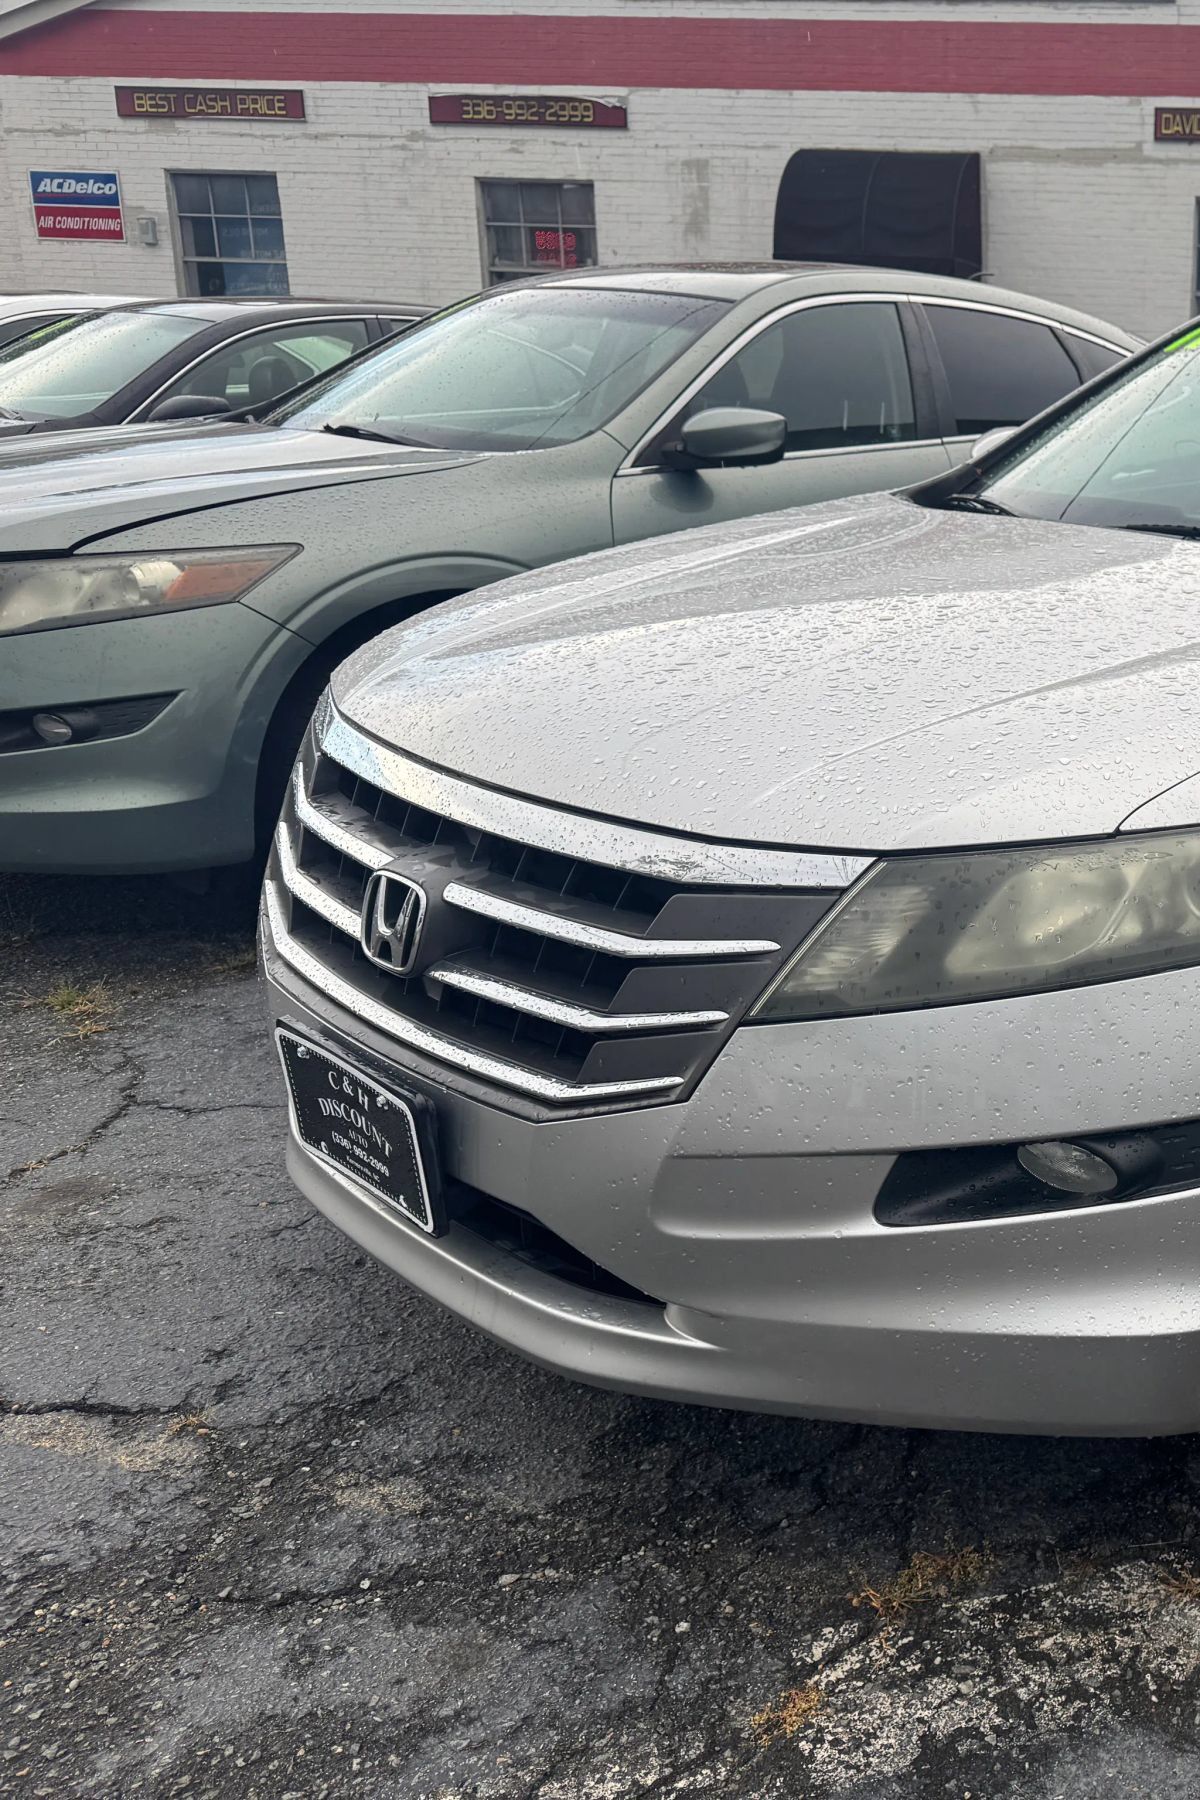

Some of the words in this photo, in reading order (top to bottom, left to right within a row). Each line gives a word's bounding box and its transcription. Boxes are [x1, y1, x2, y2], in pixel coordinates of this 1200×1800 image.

[133, 93, 177, 112] BEST
[184, 94, 231, 114] CASH
[237, 95, 287, 115] PRICE
[461, 99, 594, 122] 336-992-2999
[37, 178, 117, 194] ACDelco
[38, 215, 54, 229] AIR
[55, 216, 121, 231] CONDITIONING
[328, 1070, 341, 1090] C
[342, 1075, 354, 1096] &
[357, 1086, 369, 1112] H
[318, 1097, 393, 1158] DISCOUNT
